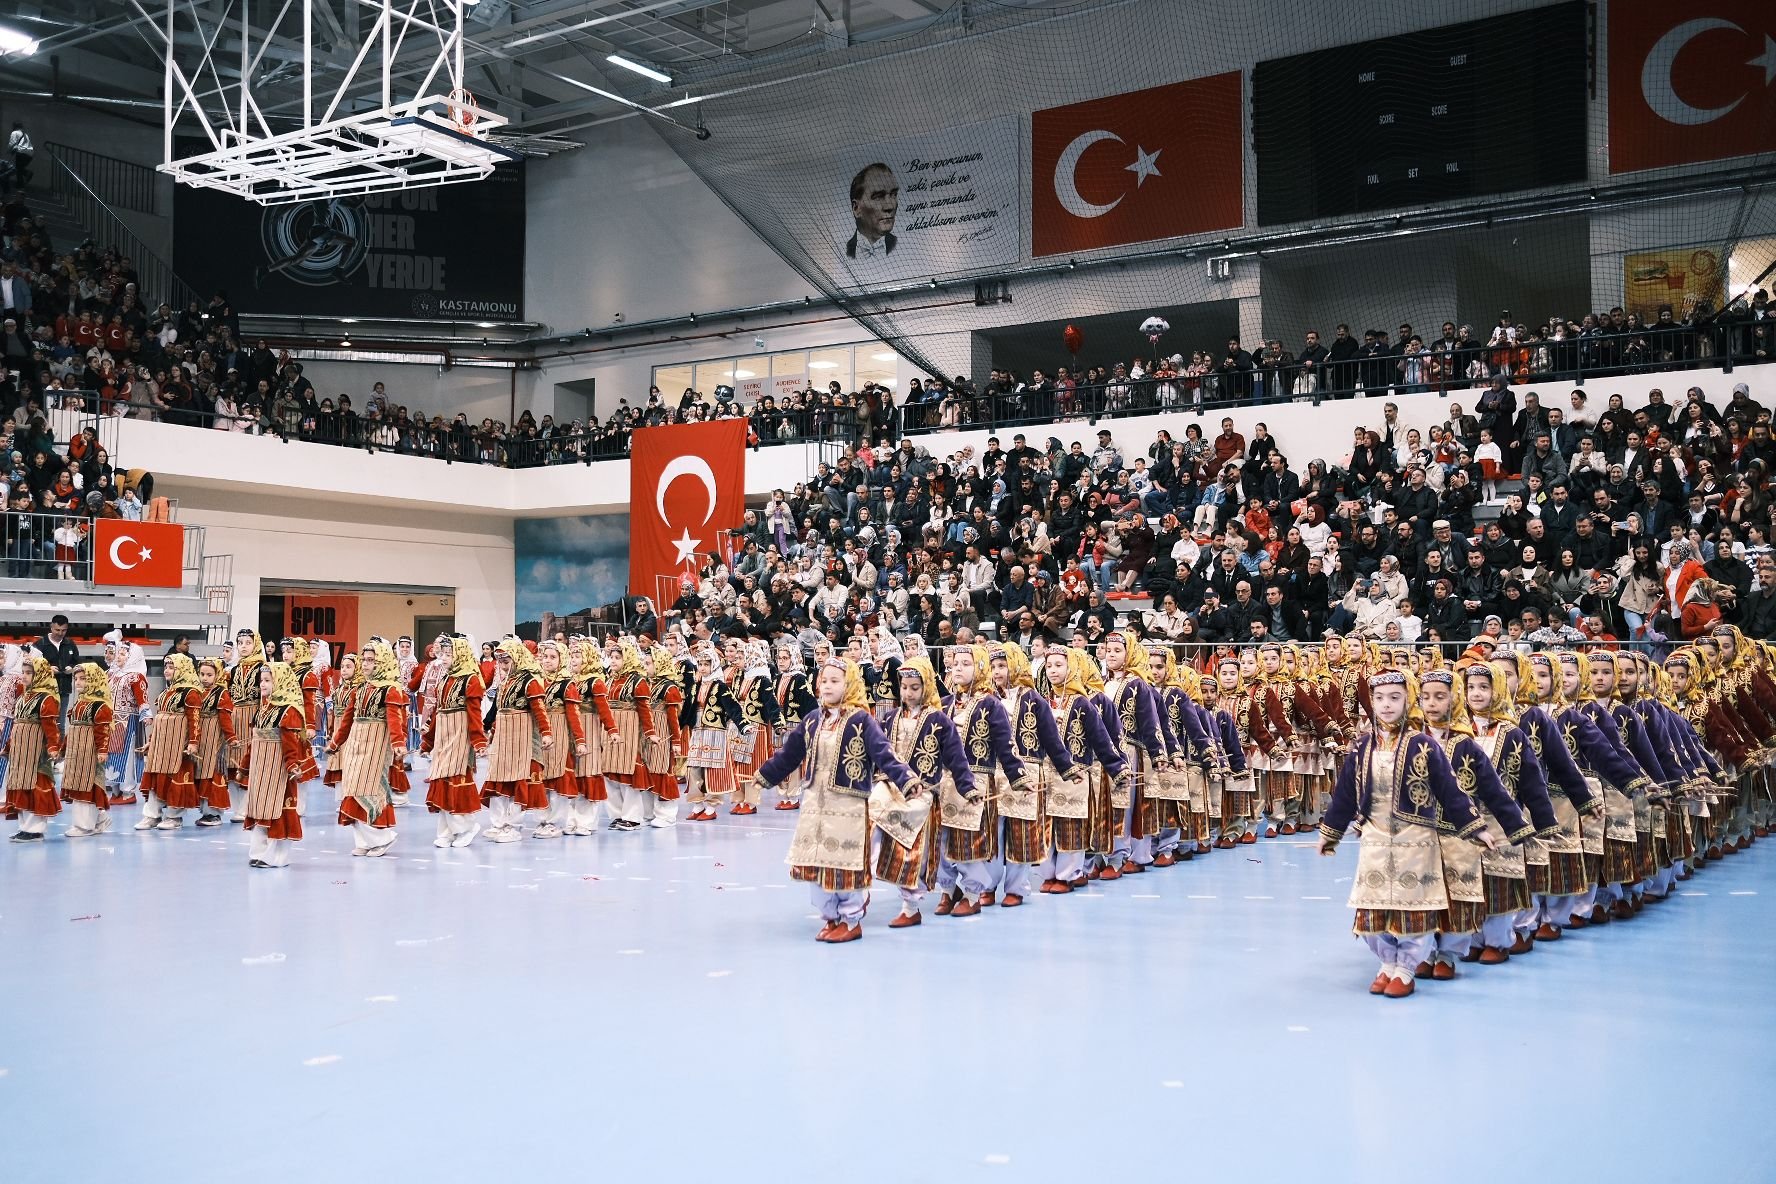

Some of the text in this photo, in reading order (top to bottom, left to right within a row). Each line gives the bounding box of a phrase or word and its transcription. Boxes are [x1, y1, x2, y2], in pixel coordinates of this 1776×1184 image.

[1449, 54, 1467, 66] GUEST
[1358, 72, 1376, 83] HOME
[1431, 104, 1447, 116] SCORE
[1378, 113, 1395, 124] SCORE
[1408, 168, 1419, 179] SET
[1446, 162, 1459, 173] FOUL
[930, 171, 957, 192] çevik
[958, 174, 972, 184] ve
[1367, 174, 1380, 185] FOUL
[930, 188, 977, 208] zamanda
[365, 213, 416, 250] HER
[365, 253, 446, 291] YERDE
[439, 299, 517, 313] KASTAMONU
[775, 379, 801, 387] AUDIENCE
[291, 606, 336, 636] SPOR
